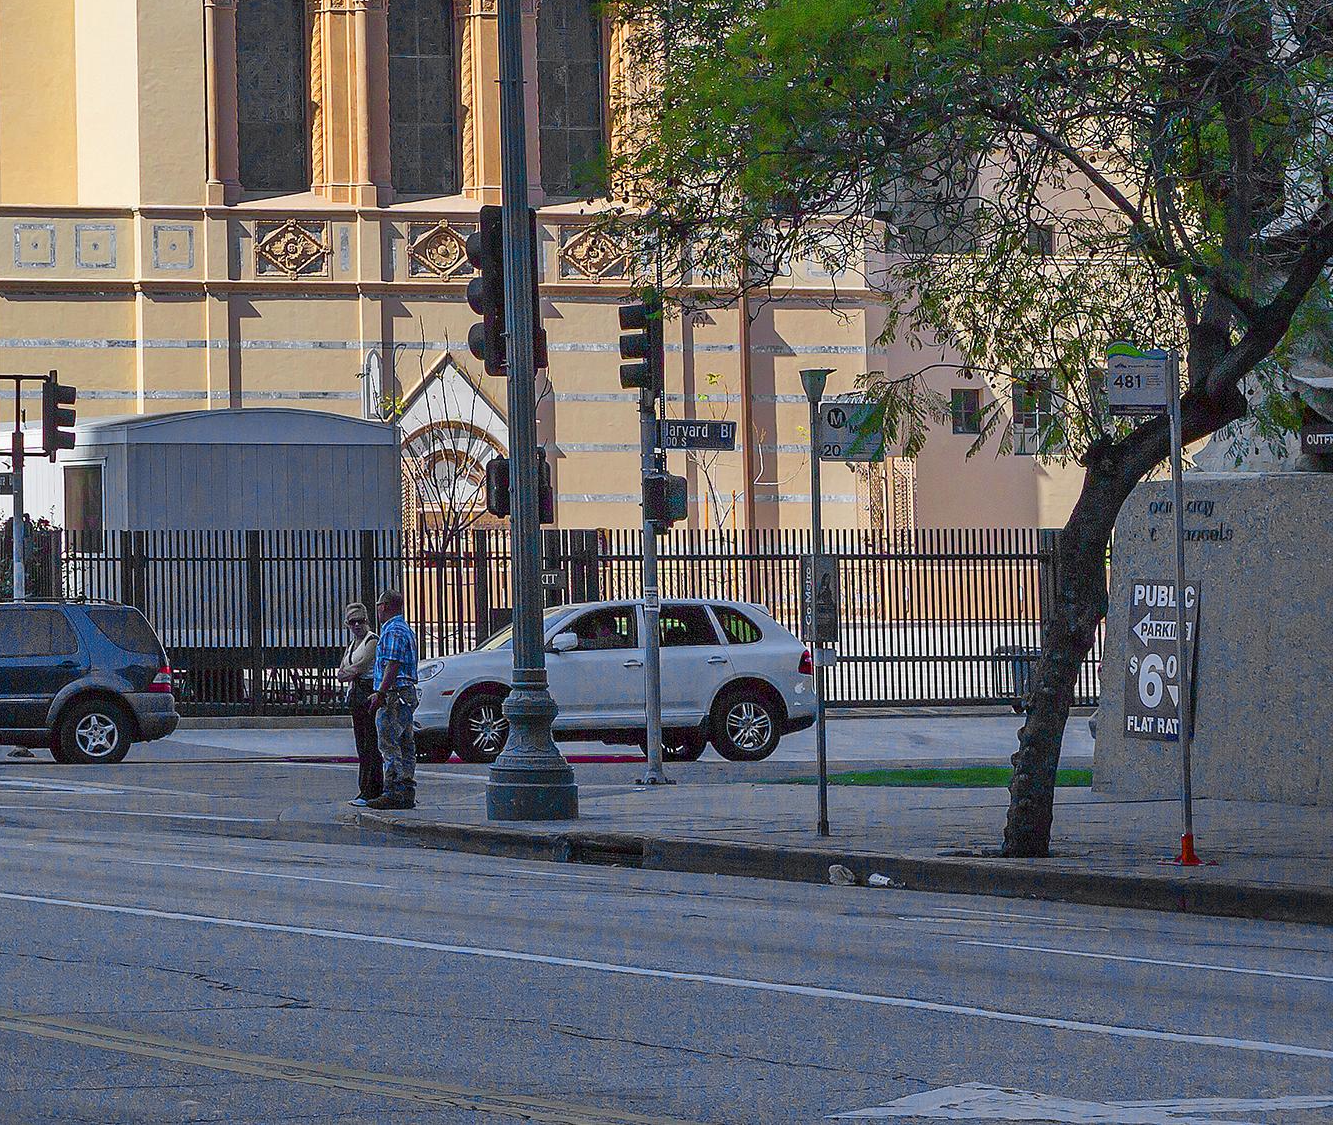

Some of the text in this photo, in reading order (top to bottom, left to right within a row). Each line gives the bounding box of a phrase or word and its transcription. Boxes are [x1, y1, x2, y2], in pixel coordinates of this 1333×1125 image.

[1113, 374, 1141, 388] 481
[720, 423, 732, 439] Bl
[681, 436, 687, 447] S
[823, 444, 842, 457] 20
[804, 566, 812, 626] Go Metro
[1133, 584, 1195, 609] PUBLC
[1126, 715, 1179, 735] FLAT RAT
